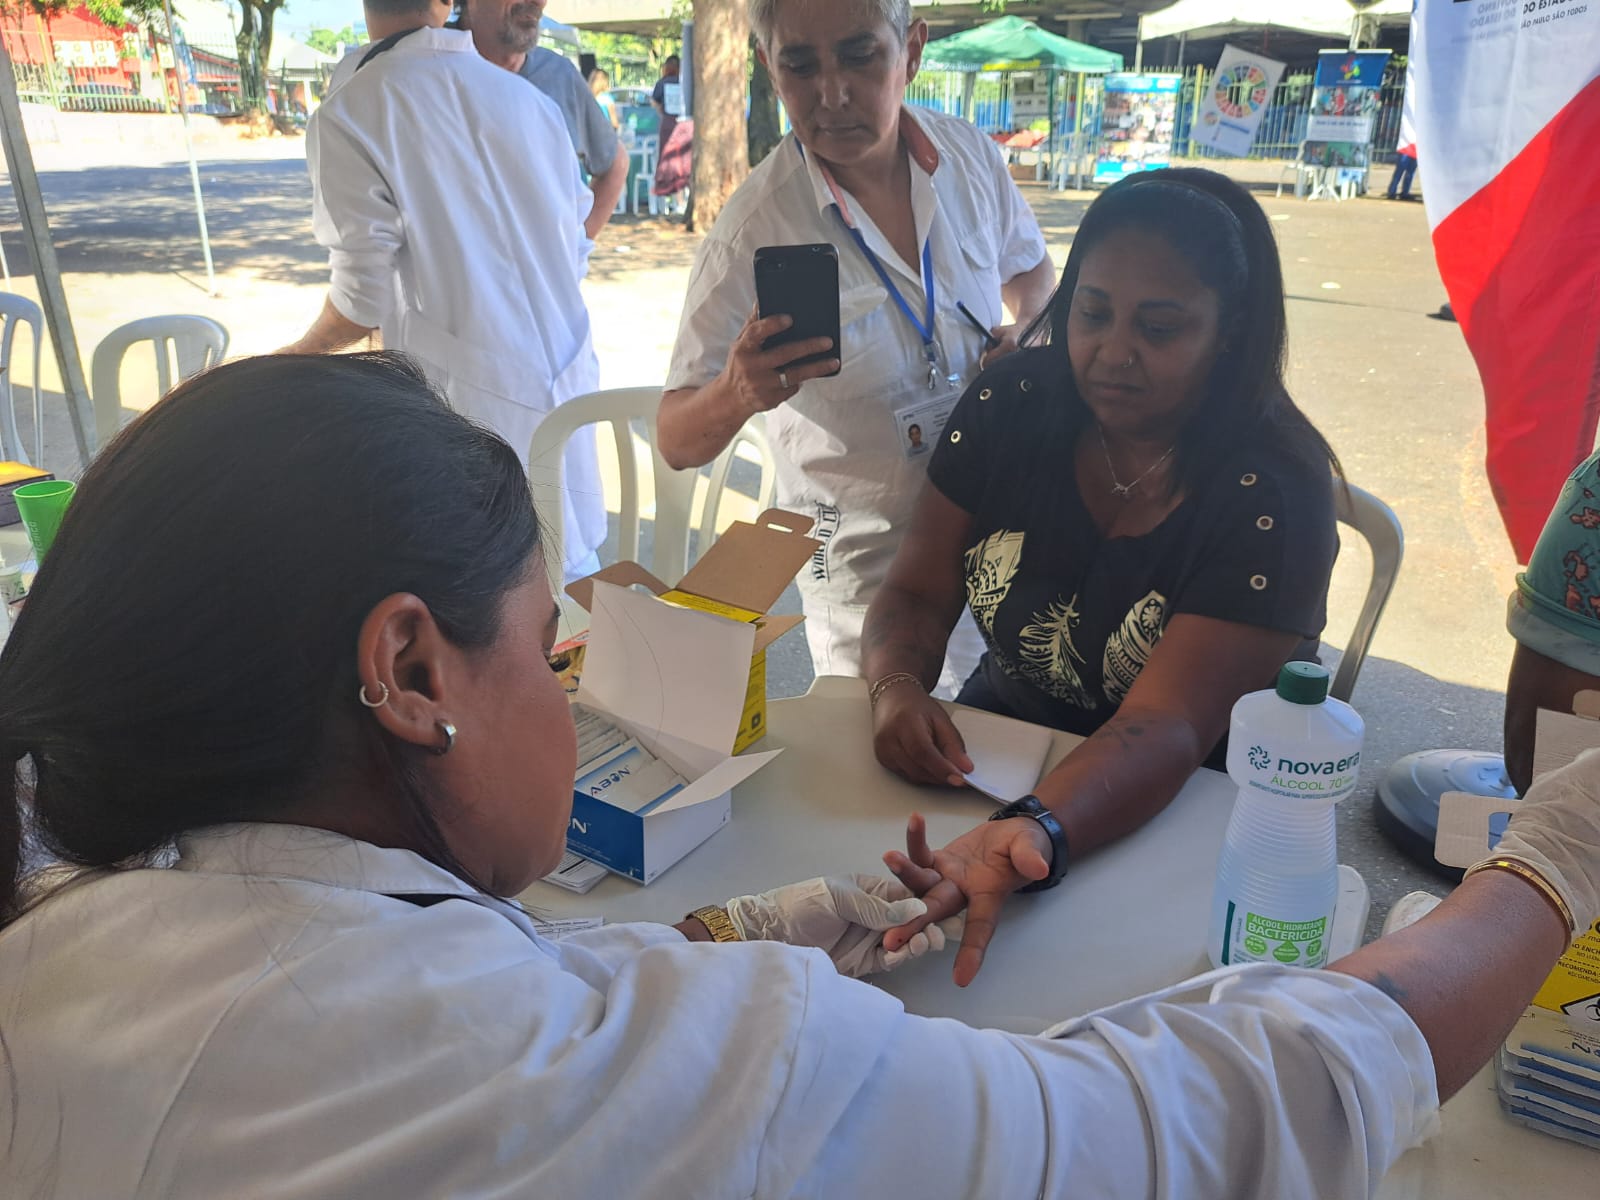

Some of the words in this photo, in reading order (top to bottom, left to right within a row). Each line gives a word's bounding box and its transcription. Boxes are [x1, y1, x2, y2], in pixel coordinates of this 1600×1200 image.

[1522, 1, 1536, 14] DO
[1552, 10, 1566, 21] SÃO
[1567, 5, 1588, 16] TODOS
[1277, 751, 1360, 776] novaera
[1247, 922, 1324, 941] BACTERICIDA
